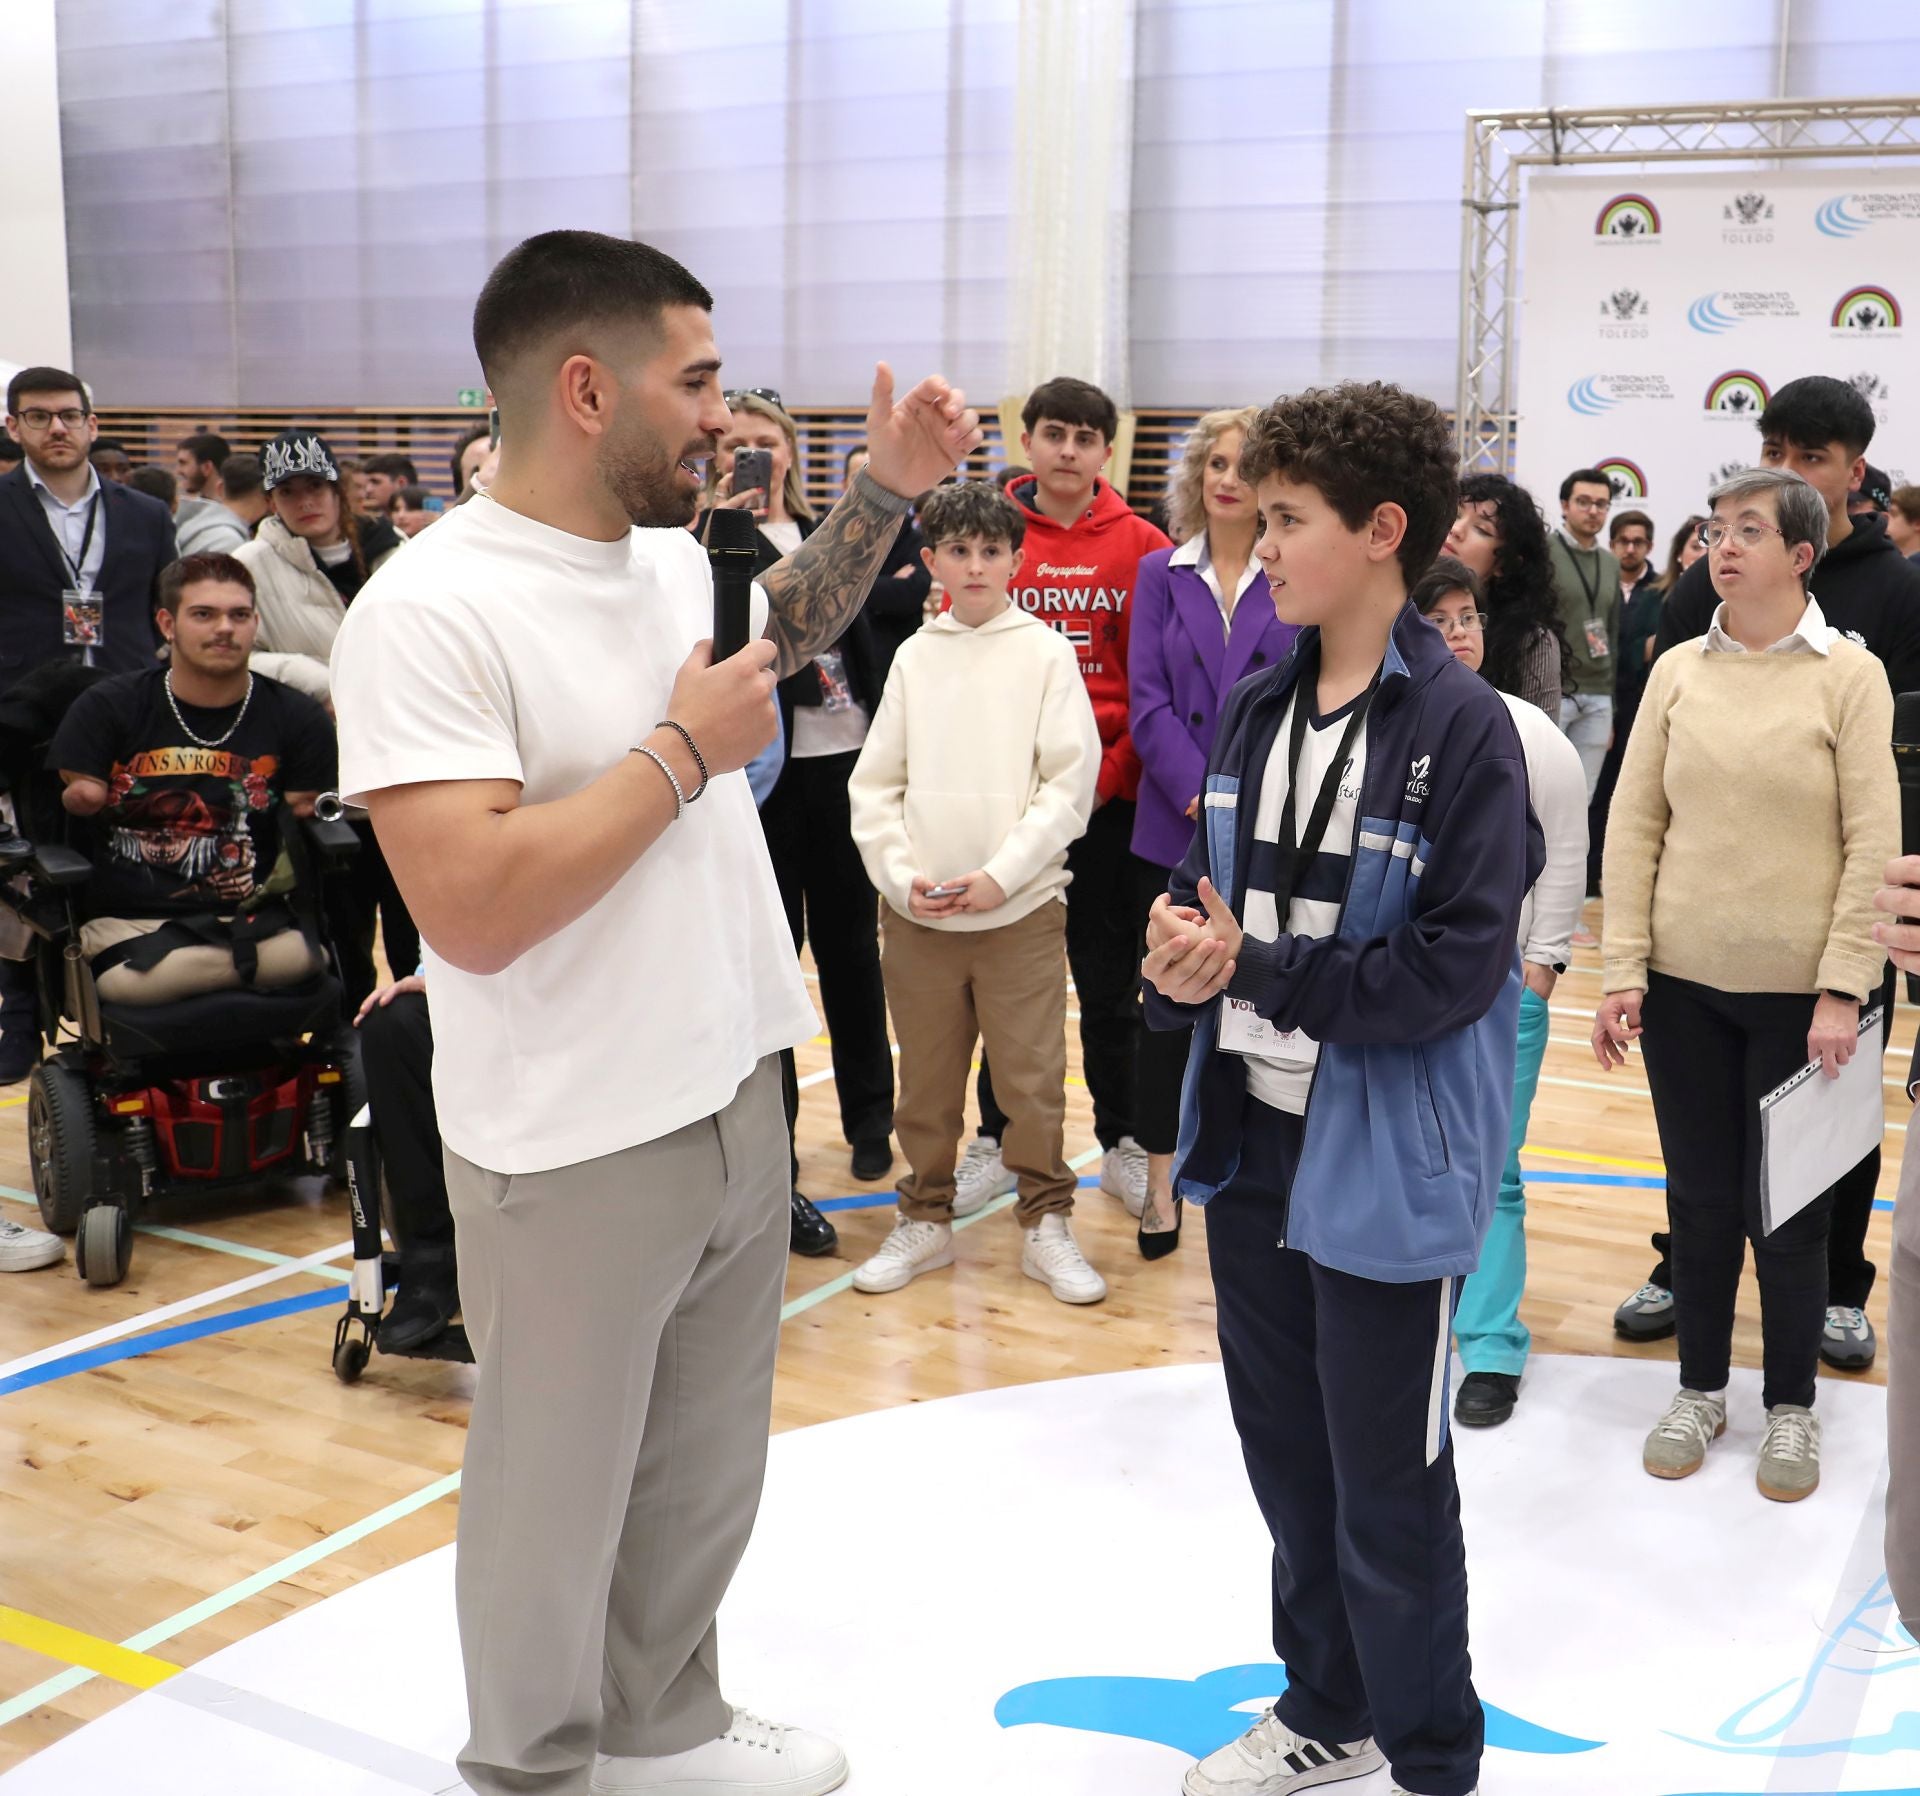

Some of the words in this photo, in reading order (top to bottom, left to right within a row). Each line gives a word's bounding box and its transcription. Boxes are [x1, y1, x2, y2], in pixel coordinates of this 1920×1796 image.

[1722, 233, 1775, 244] TOLEDO
[1723, 292, 1791, 301] PATRONATO
[1733, 301, 1795, 310] DEPORTIVO
[1599, 329, 1648, 340] TOLEDO
[1601, 374, 1665, 384] PATRONATO
[1610, 384, 1670, 393] DEPORTIVO
[1036, 562, 1098, 578] Geographical
